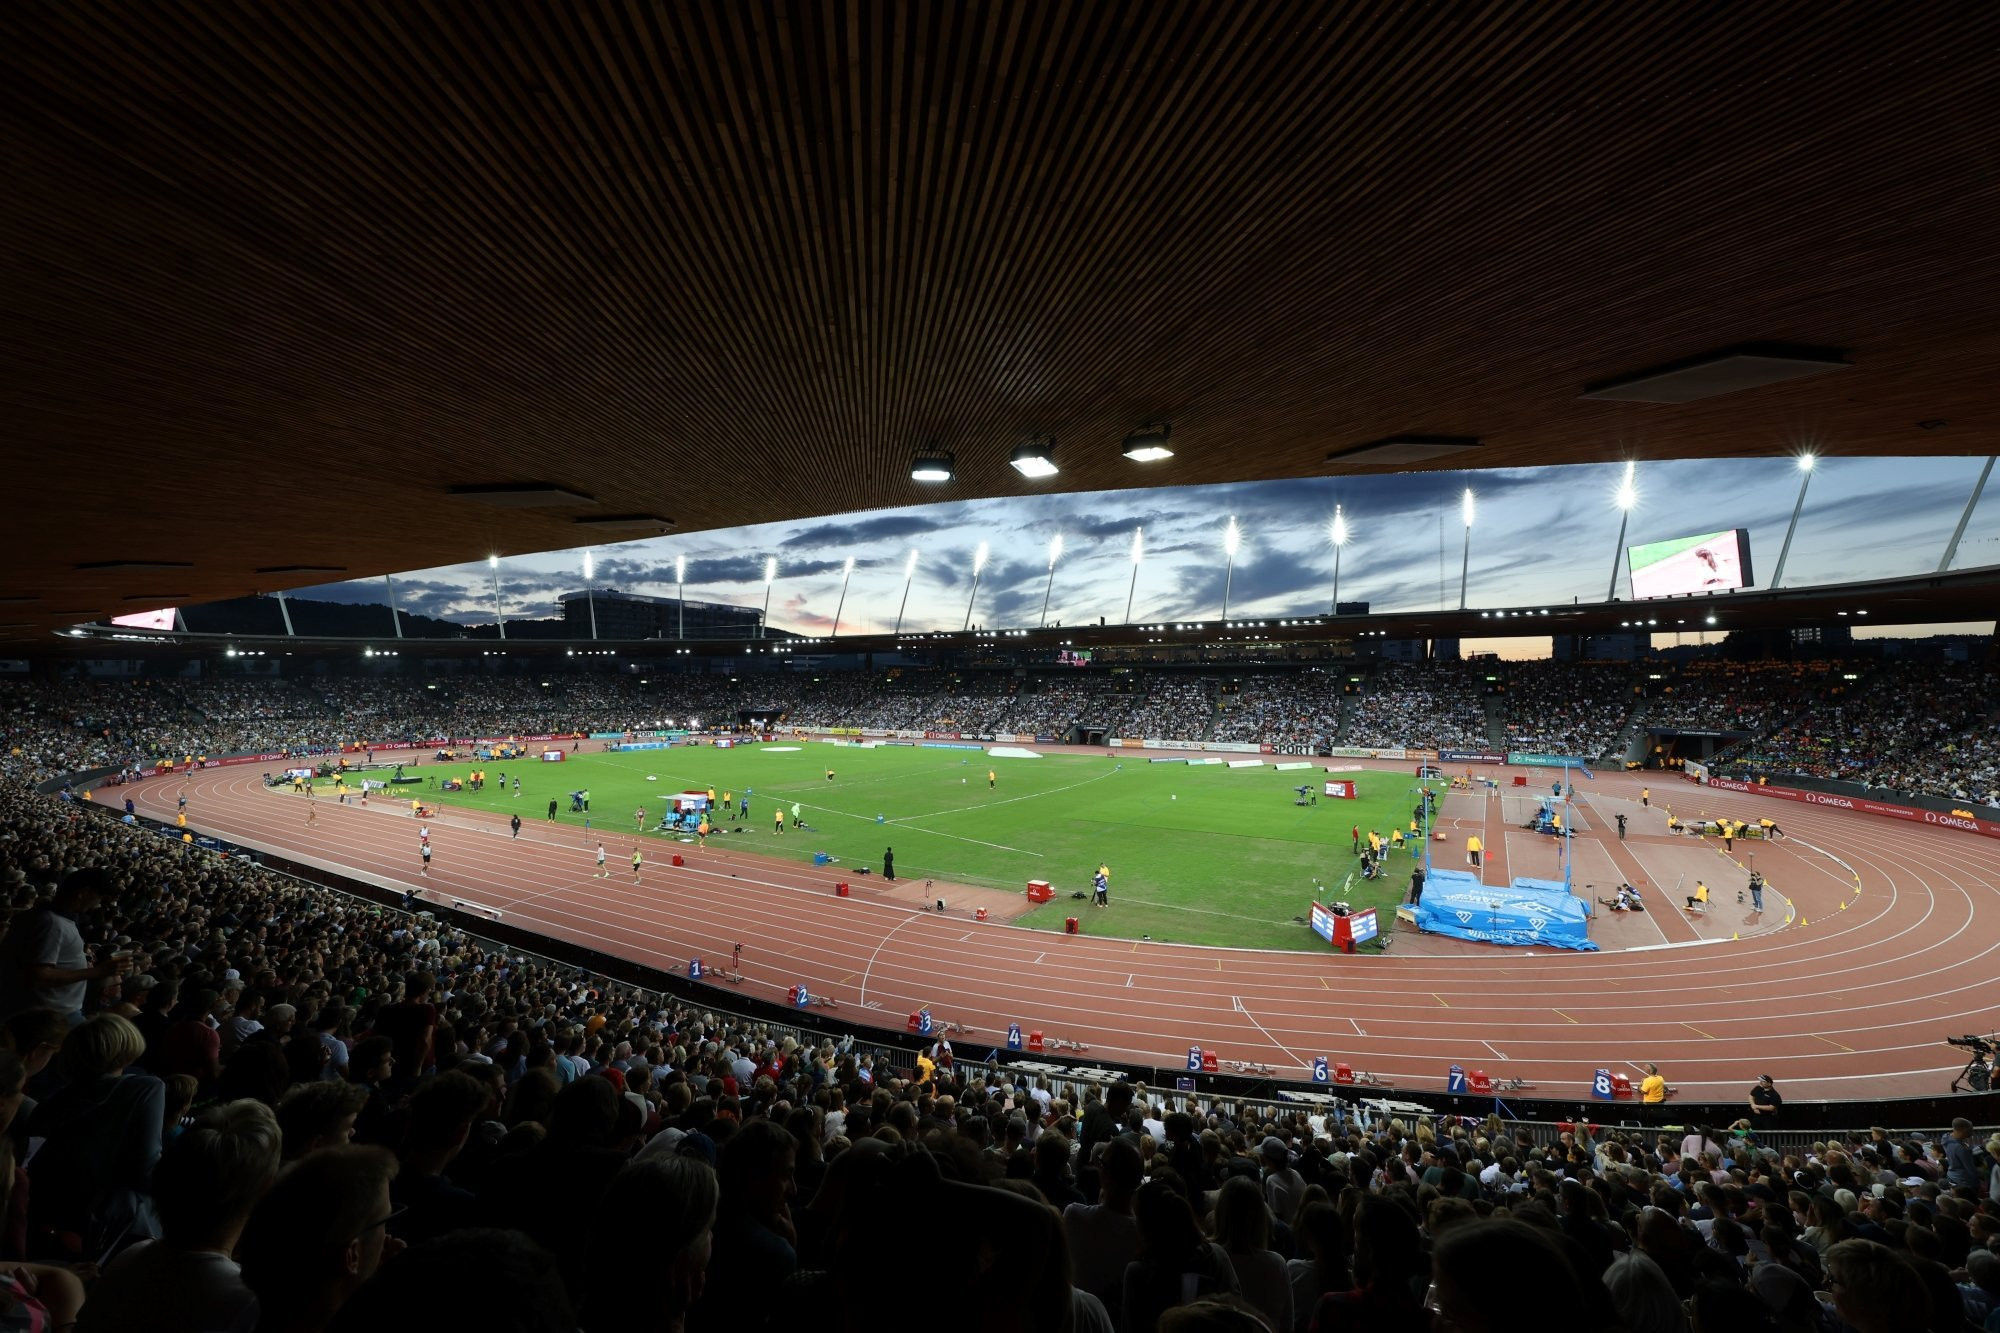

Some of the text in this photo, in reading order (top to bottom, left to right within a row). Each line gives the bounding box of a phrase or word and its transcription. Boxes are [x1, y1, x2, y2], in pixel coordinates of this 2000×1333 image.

[936, 732, 955, 740] OMEGA
[1272, 743, 1310, 755] SPORT
[1720, 781, 1749, 792] OMEGA
[1818, 796, 1854, 809] OMEGA
[1939, 815, 1979, 831] OMEGA
[692, 962, 700, 976] 1
[799, 988, 808, 1003] 2
[924, 1015, 932, 1031] 3
[1008, 1029, 1020, 1045] 4
[1190, 1053, 1200, 1070] 5
[1315, 1064, 1326, 1081] 6
[1451, 1073, 1463, 1090] 7
[1596, 1075, 1610, 1094] 8
